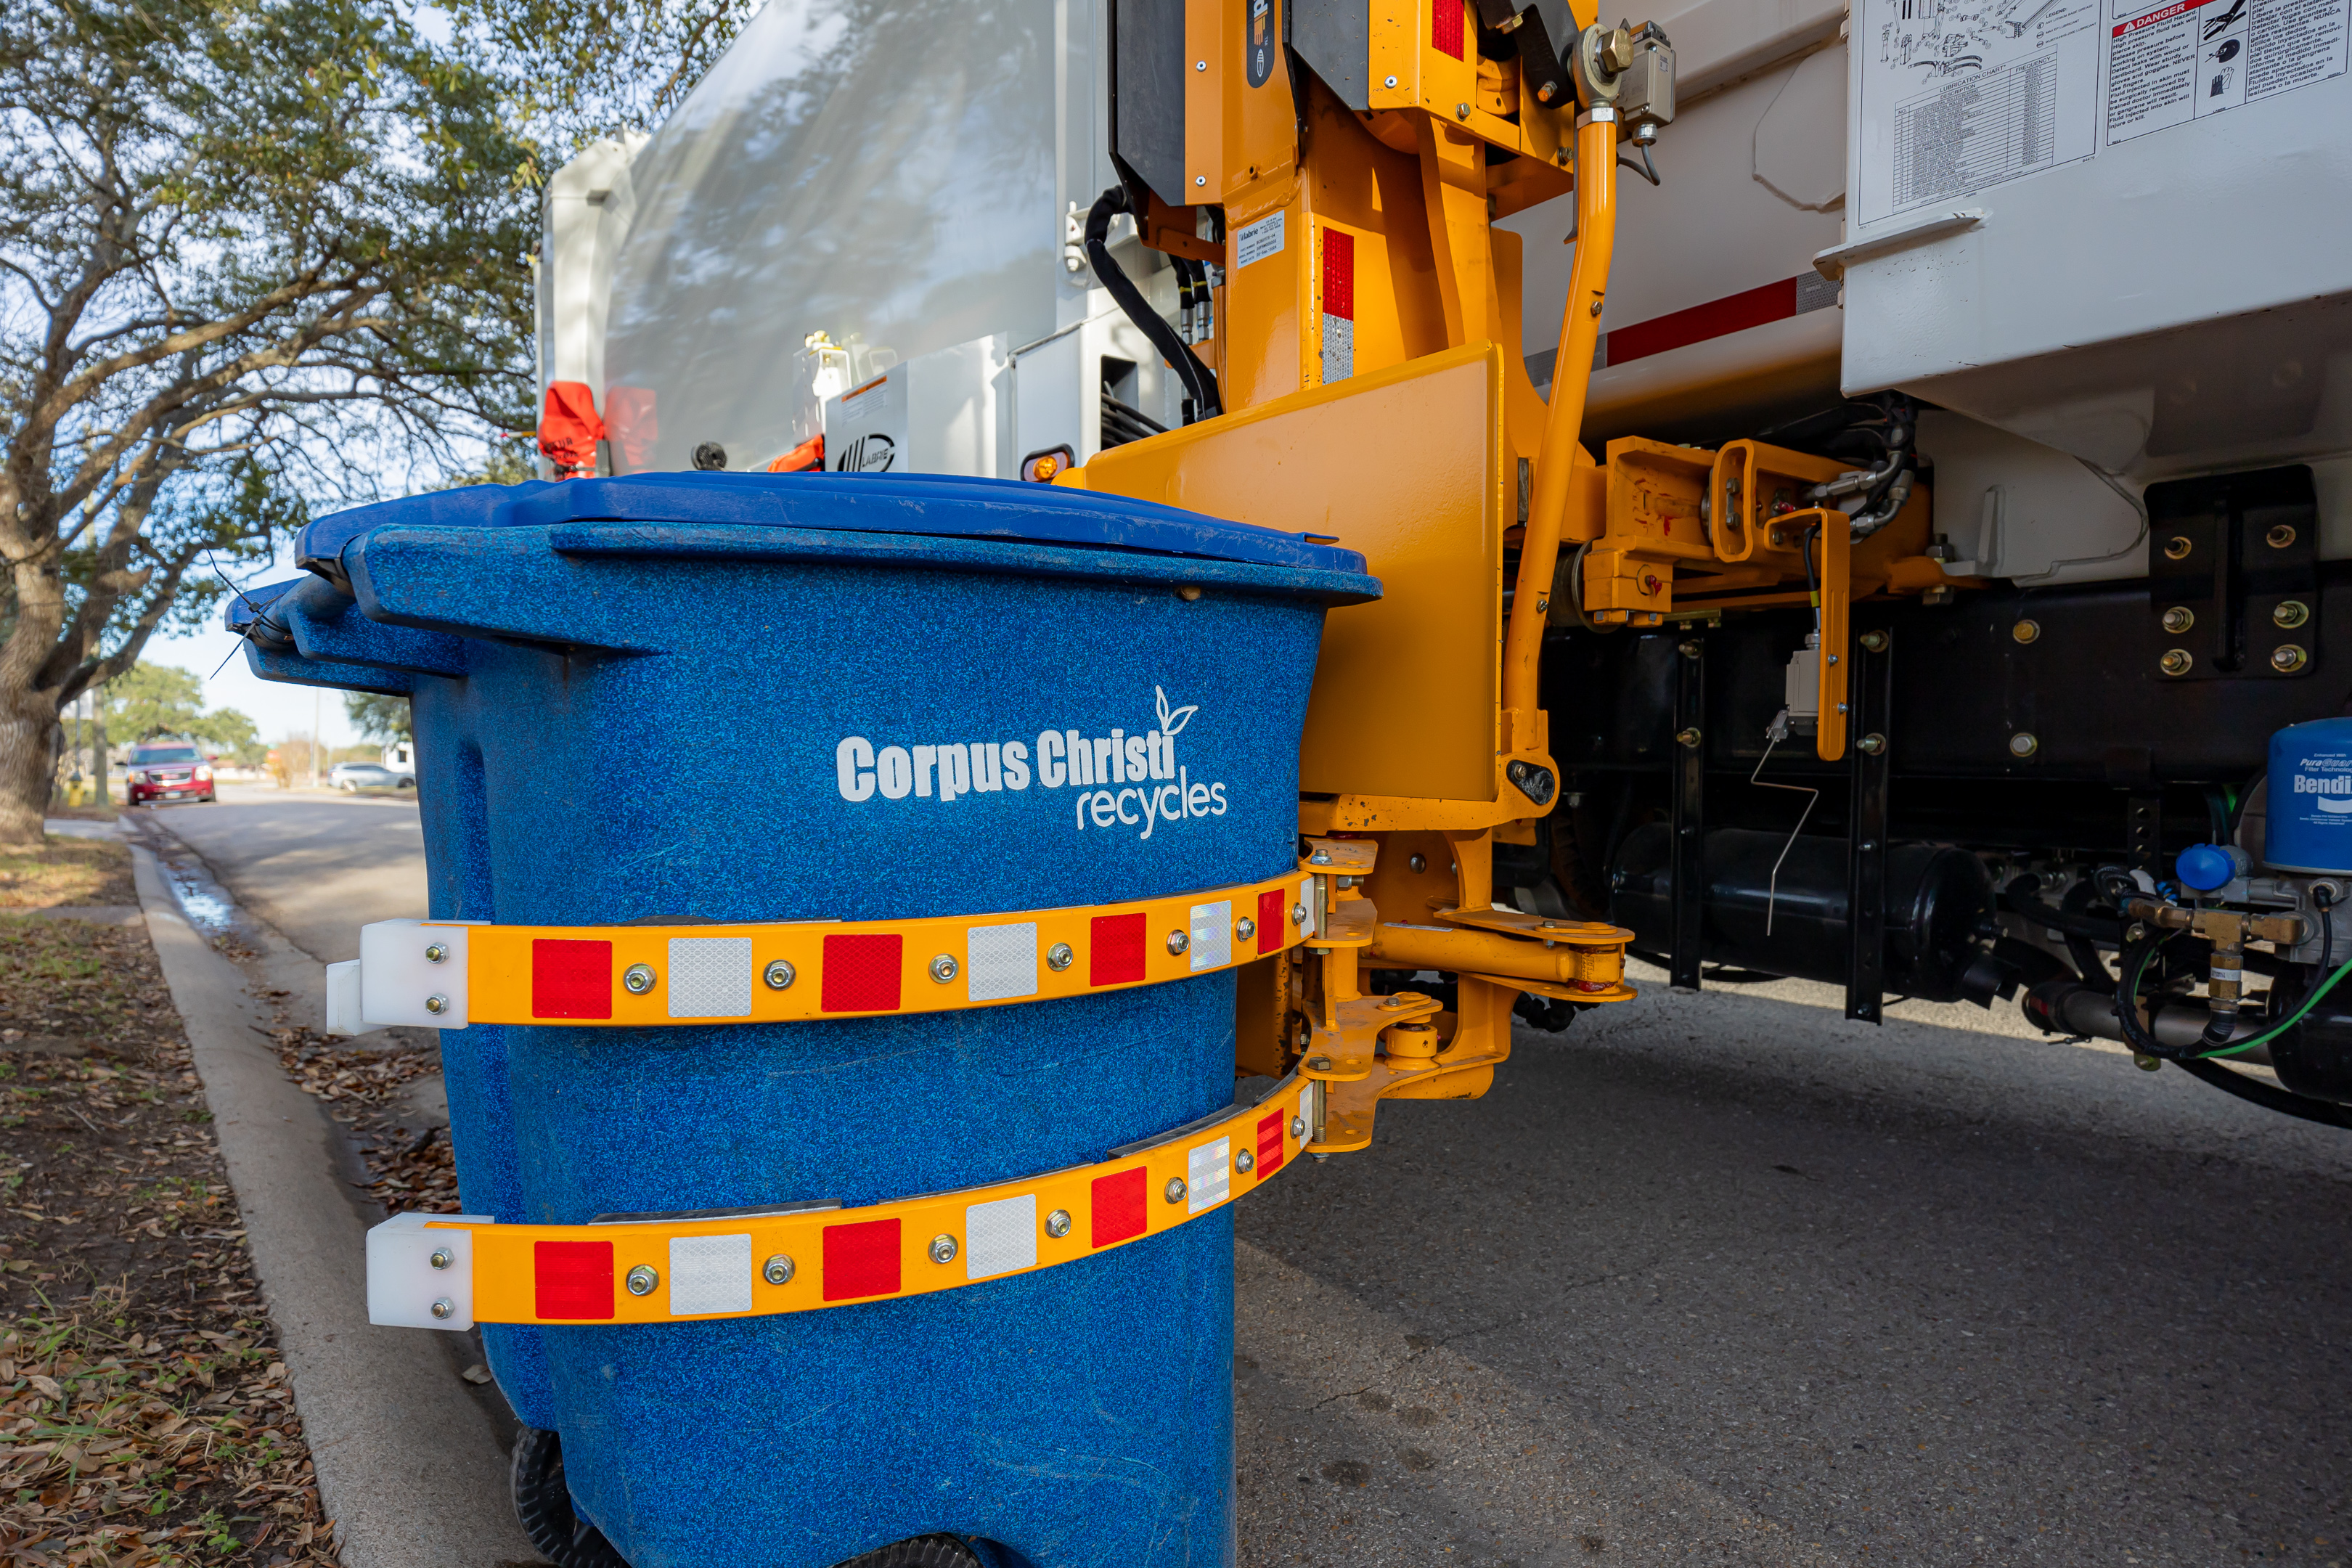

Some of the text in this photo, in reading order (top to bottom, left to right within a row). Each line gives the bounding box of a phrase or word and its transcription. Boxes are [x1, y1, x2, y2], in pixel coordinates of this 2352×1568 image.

[2136, 3, 2185, 27] DANGER
[2251, 13, 2278, 25] trabajar
[2251, 18, 2280, 31] Detectar
[2282, 11, 2301, 21] fugas
[2252, 7, 2263, 16] piel
[2252, 9, 2273, 20] Libere
[2257, 24, 2281, 35] cartón.
[2298, 8, 2327, 22] guantes
[2113, 9, 2197, 44] High Pressure Fluid Hazard.
[2113, 41, 2127, 49] High
[2128, 31, 2155, 45] pressure
[2156, 25, 2170, 34] fluid
[2171, 20, 2184, 29] leak
[2250, 33, 2269, 44] gafas
[2314, 8, 2341, 21] NUNCA
[2250, 38, 2271, 48] utilice
[2285, 25, 2309, 36] dedos.
[2112, 33, 2185, 62] Release pressure before
[2112, 46, 2131, 57] pierce
[2112, 57, 2136, 68] working
[2146, 45, 2170, 56] system.
[2250, 51, 2262, 60] piel
[2263, 44, 2285, 54] tienen
[2287, 39, 2300, 48] que
[2015, 56, 2051, 73] FREQUENCY
[2111, 77, 2131, 87] gloves
[2144, 64, 2171, 76] goggles.
[2173, 54, 2195, 66] NEVER
[2112, 64, 2131, 74] Detect
[2163, 46, 2181, 57] wood
[2112, 53, 2182, 80] cardboard. Wear sturdy
[2249, 62, 2280, 75] atamente
[2296, 46, 2330, 62] gangrena
[2249, 58, 2275, 70] informe
[1940, 73, 1980, 93] LUBRICATION
[2123, 78, 2145, 89] fingers.
[2247, 84, 2261, 94] piel
[2262, 76, 2288, 89] pueden
[2290, 64, 2325, 79] ocasionar
[2248, 61, 2303, 83] puede aparecer.
[2248, 75, 2274, 86] Fluidos
[1940, 83, 1976, 100] DESCRIPTION
[2110, 90, 2126, 99] Fluid
[2126, 81, 2150, 93] injected
[2173, 69, 2189, 78] must
[2119, 89, 2148, 102] surgically
[2149, 79, 2176, 92] removed
[2247, 85, 2277, 97] lesiones
[2292, 72, 2319, 83] muerte.
[2110, 82, 2191, 111] trained doctor immediately
[2117, 102, 2145, 115] gangrene
[2158, 91, 2178, 102] result.
[2126, 107, 2149, 118] injected
[1244, 228, 1259, 240] labrie
[862, 448, 889, 467] LABRIE
[836, 728, 1175, 802] Corpus Christi
[2294, 775, 2352, 794] Bendi
[1077, 765, 1227, 839] recycles
